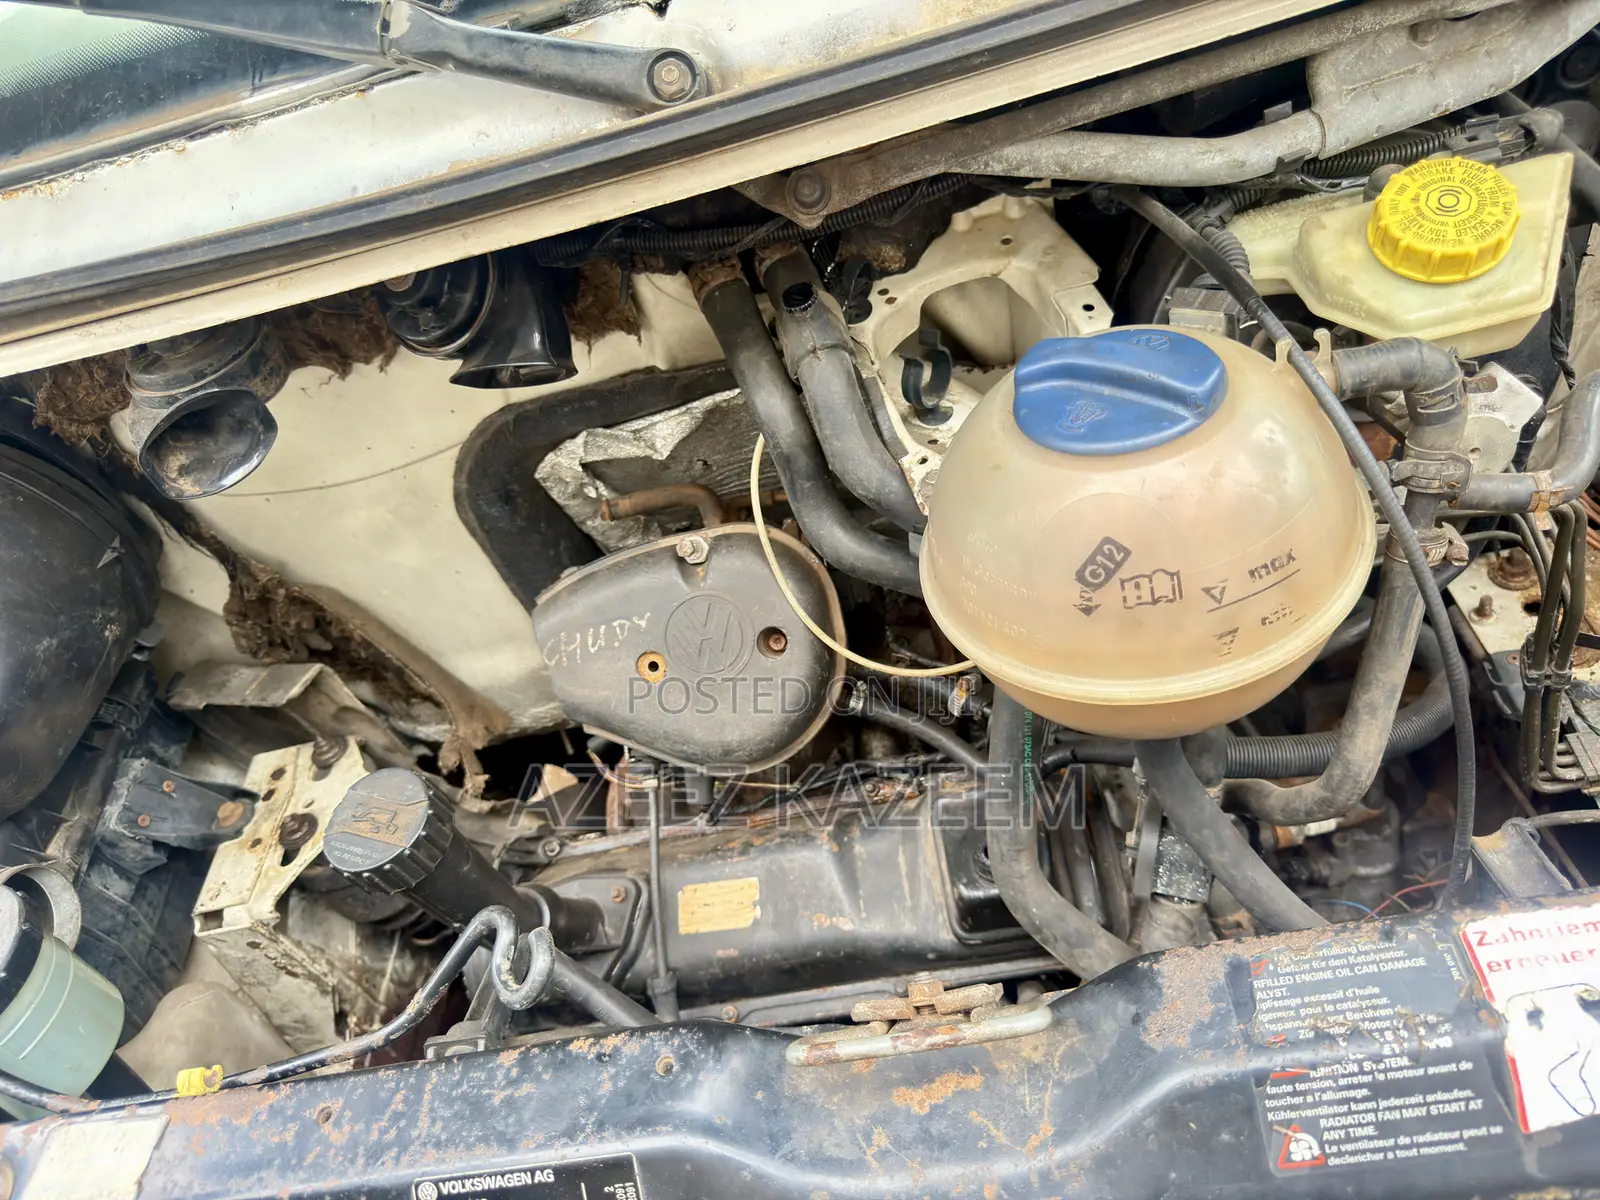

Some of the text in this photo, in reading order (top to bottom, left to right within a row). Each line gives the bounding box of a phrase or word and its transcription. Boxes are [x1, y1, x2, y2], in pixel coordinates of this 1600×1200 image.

[1458, 160, 1488, 175] CLEAN
[1085, 541, 1127, 588] G12
[1247, 547, 1297, 583] max
[1348, 949, 1408, 966] Katalysator.
[1295, 970, 1335, 983] ENGINE
[1335, 965, 1354, 978] OIL
[1354, 962, 1379, 976] CAN
[1379, 957, 1428, 973] DAMAGE
[1303, 989, 1345, 1002] excessif
[1386, 1067, 1425, 1080] moteur
[1426, 1062, 1457, 1075] avant
[1458, 1060, 1473, 1071] de
[1264, 1095, 1305, 1108] toucher
[1267, 1103, 1350, 1121] Kühlerventilator
[1349, 1101, 1377, 1112] kann
[1378, 1093, 1424, 1109] jederzeit
[1319, 1098, 1484, 1128] RADIATOR FAN MAY START AT
[1322, 1128, 1347, 1141] ANY
[1325, 1143, 1339, 1154] Le
[1339, 1137, 1396, 1152] ventilateur
[1396, 1135, 1412, 1146] de
[1412, 1131, 1461, 1143] radiateur
[1327, 1151, 1386, 1166] declencher
[1394, 1147, 1419, 1159] tout
[438, 1171, 532, 1196] VOLKSWAGEN
[533, 1168, 556, 1184] AG
